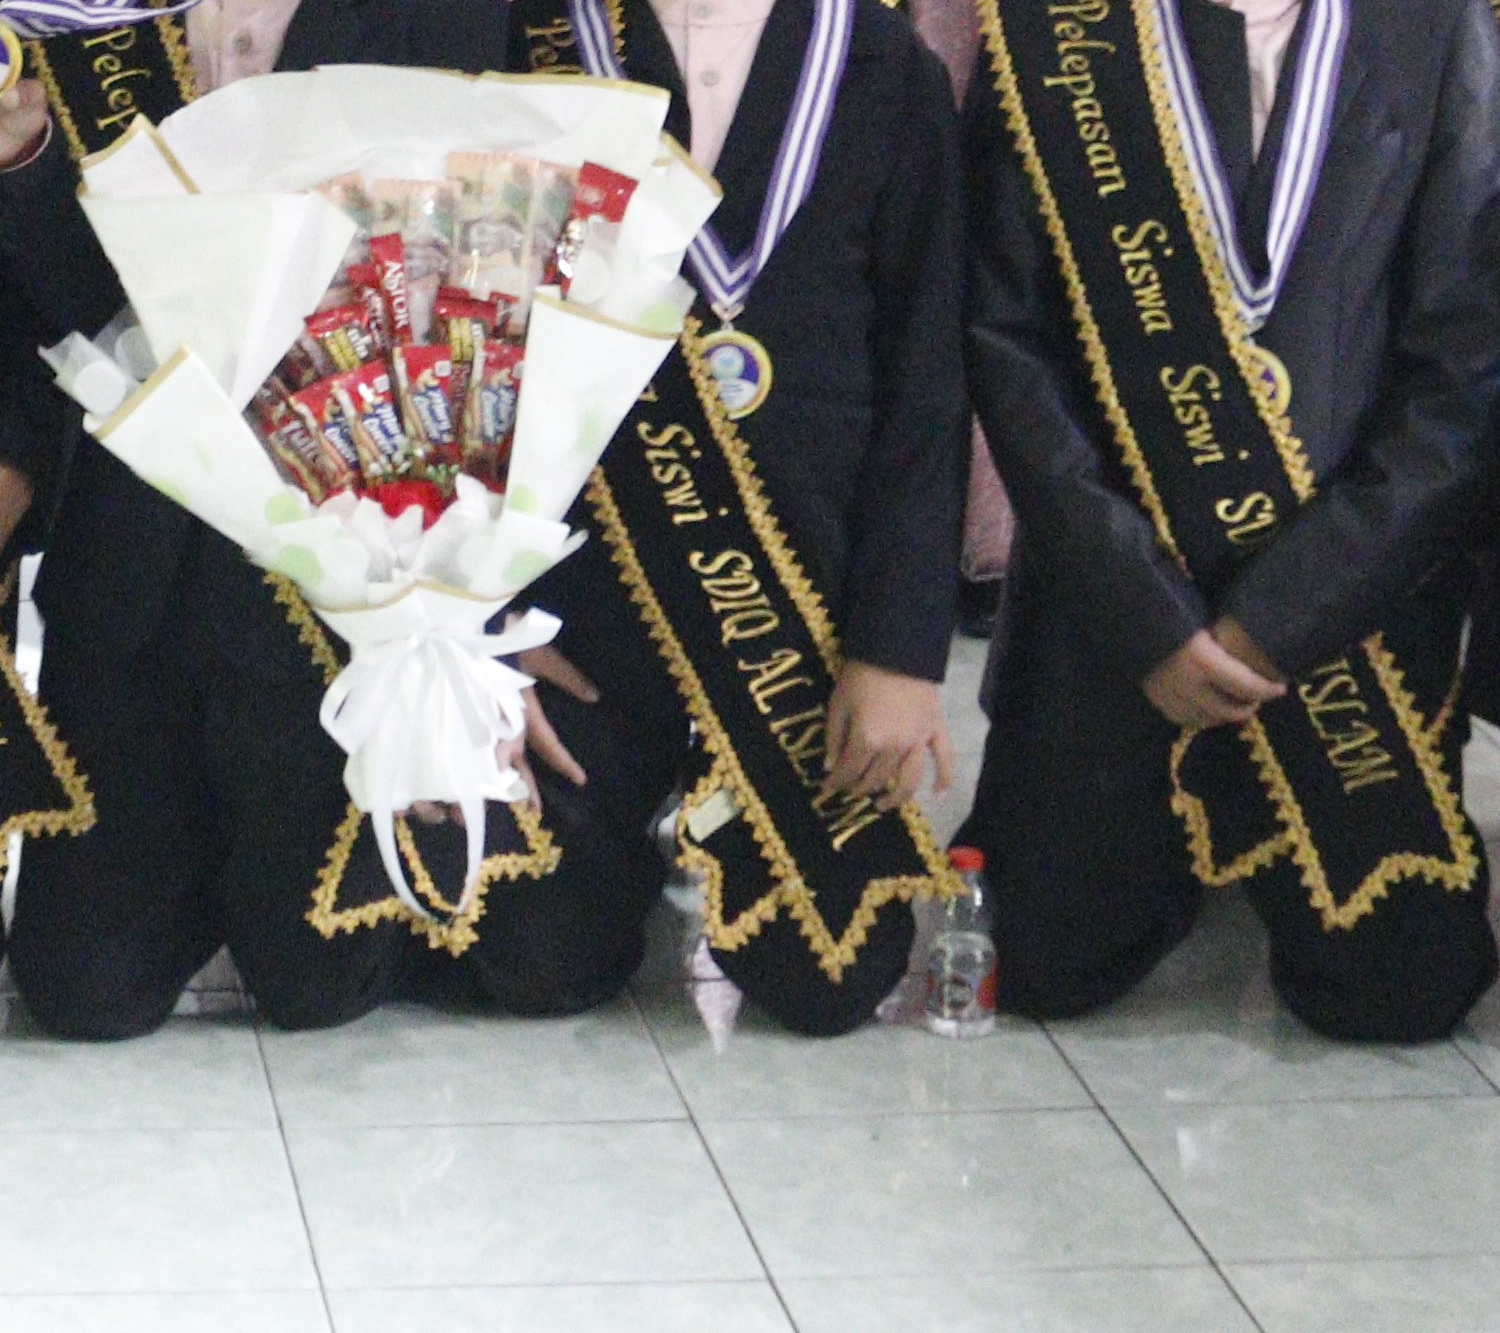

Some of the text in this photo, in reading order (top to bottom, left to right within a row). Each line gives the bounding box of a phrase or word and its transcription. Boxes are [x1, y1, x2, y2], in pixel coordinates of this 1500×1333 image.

[83, 26, 152, 131] Pelep
[1111, 218, 1173, 336] Siswa
[1160, 364, 1251, 467] Siswi
[638, 422, 728, 525] Siswi
[689, 547, 781, 645] SDIQ
[738, 648, 814, 714] AL
